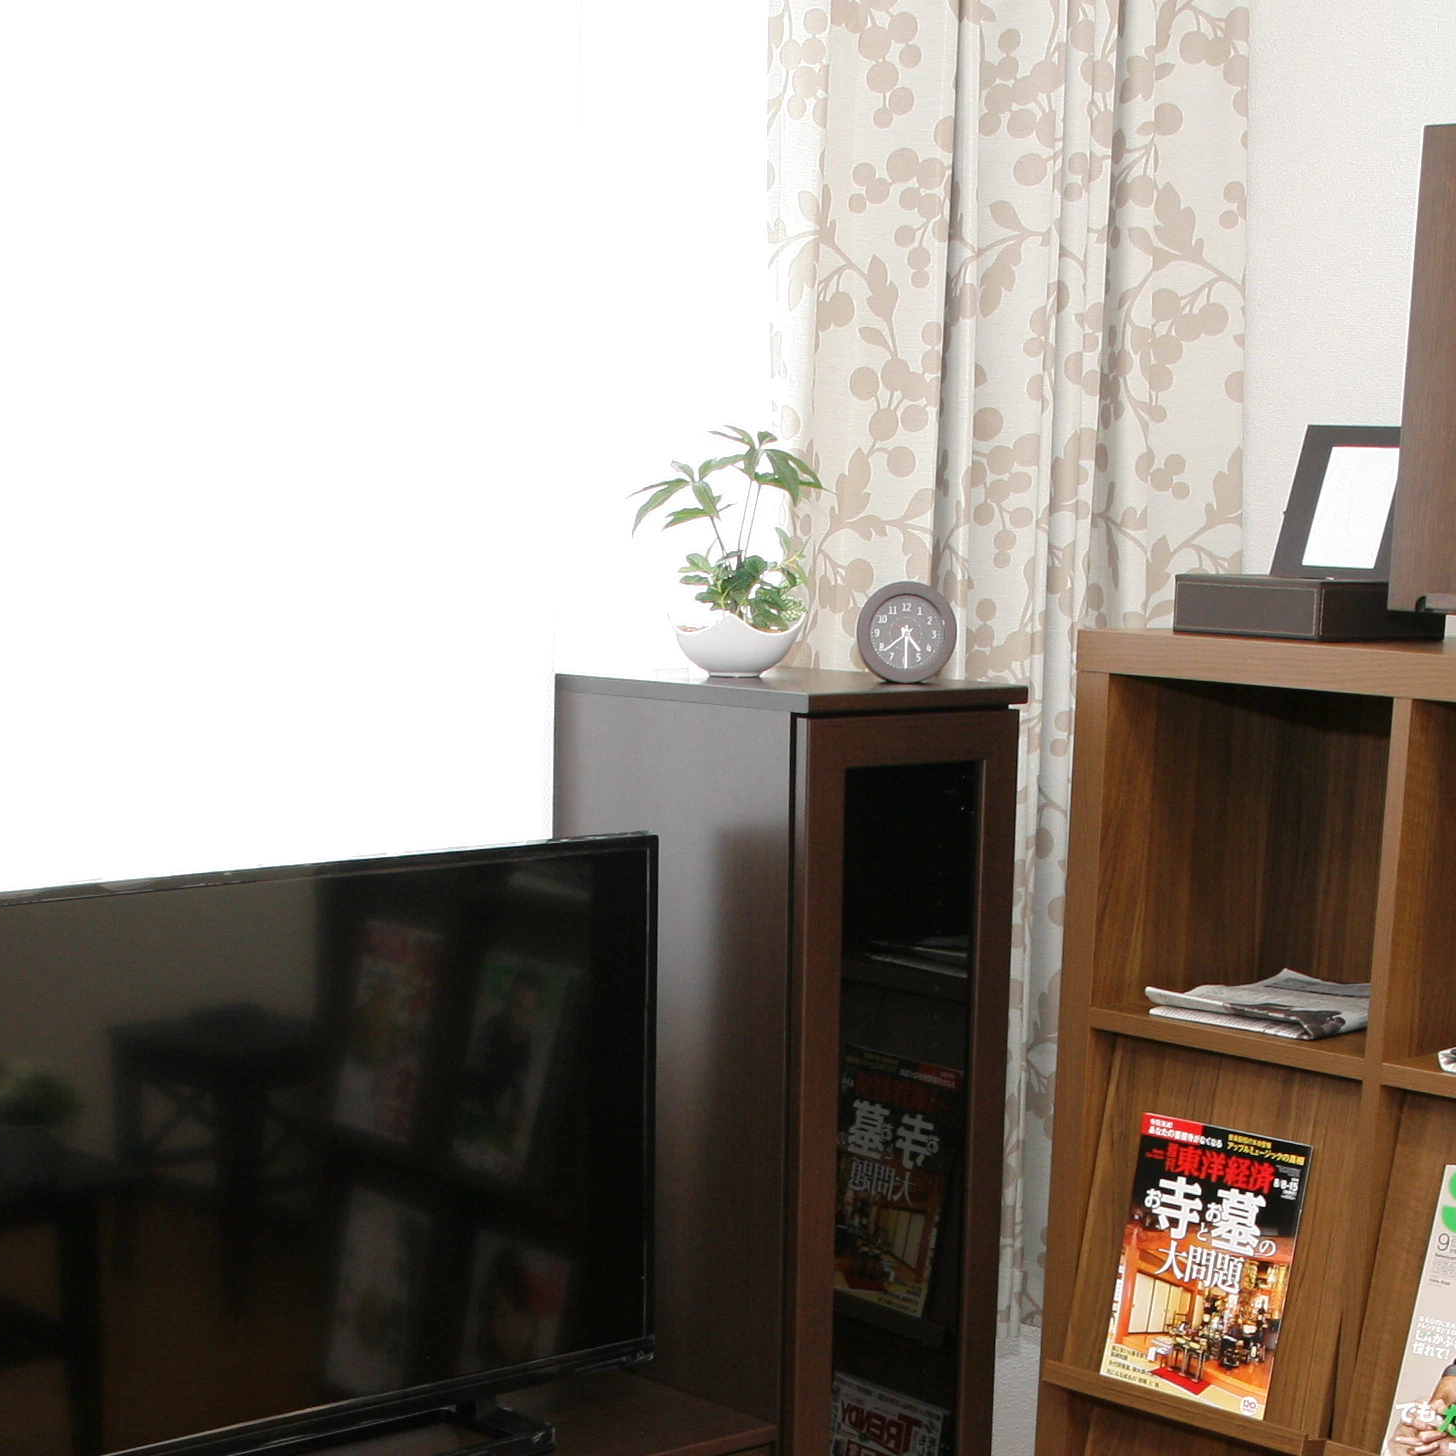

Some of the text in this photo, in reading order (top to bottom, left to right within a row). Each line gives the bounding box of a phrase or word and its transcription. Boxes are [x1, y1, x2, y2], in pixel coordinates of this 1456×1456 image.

[888, 606, 897, 614] 11
[902, 602, 912, 612] 12
[917, 606, 922, 616] 1
[878, 614, 888, 624] 10
[927, 616, 932, 626] 2
[874, 628, 880, 638] 9
[932, 630, 936, 639] 3
[926, 644, 932, 652] 4
[890, 652, 894, 660] 7
[916, 652, 922, 662] 5
[1437, 1233, 1450, 1251] 9
[1153, 1240, 1244, 1294] 大問題
